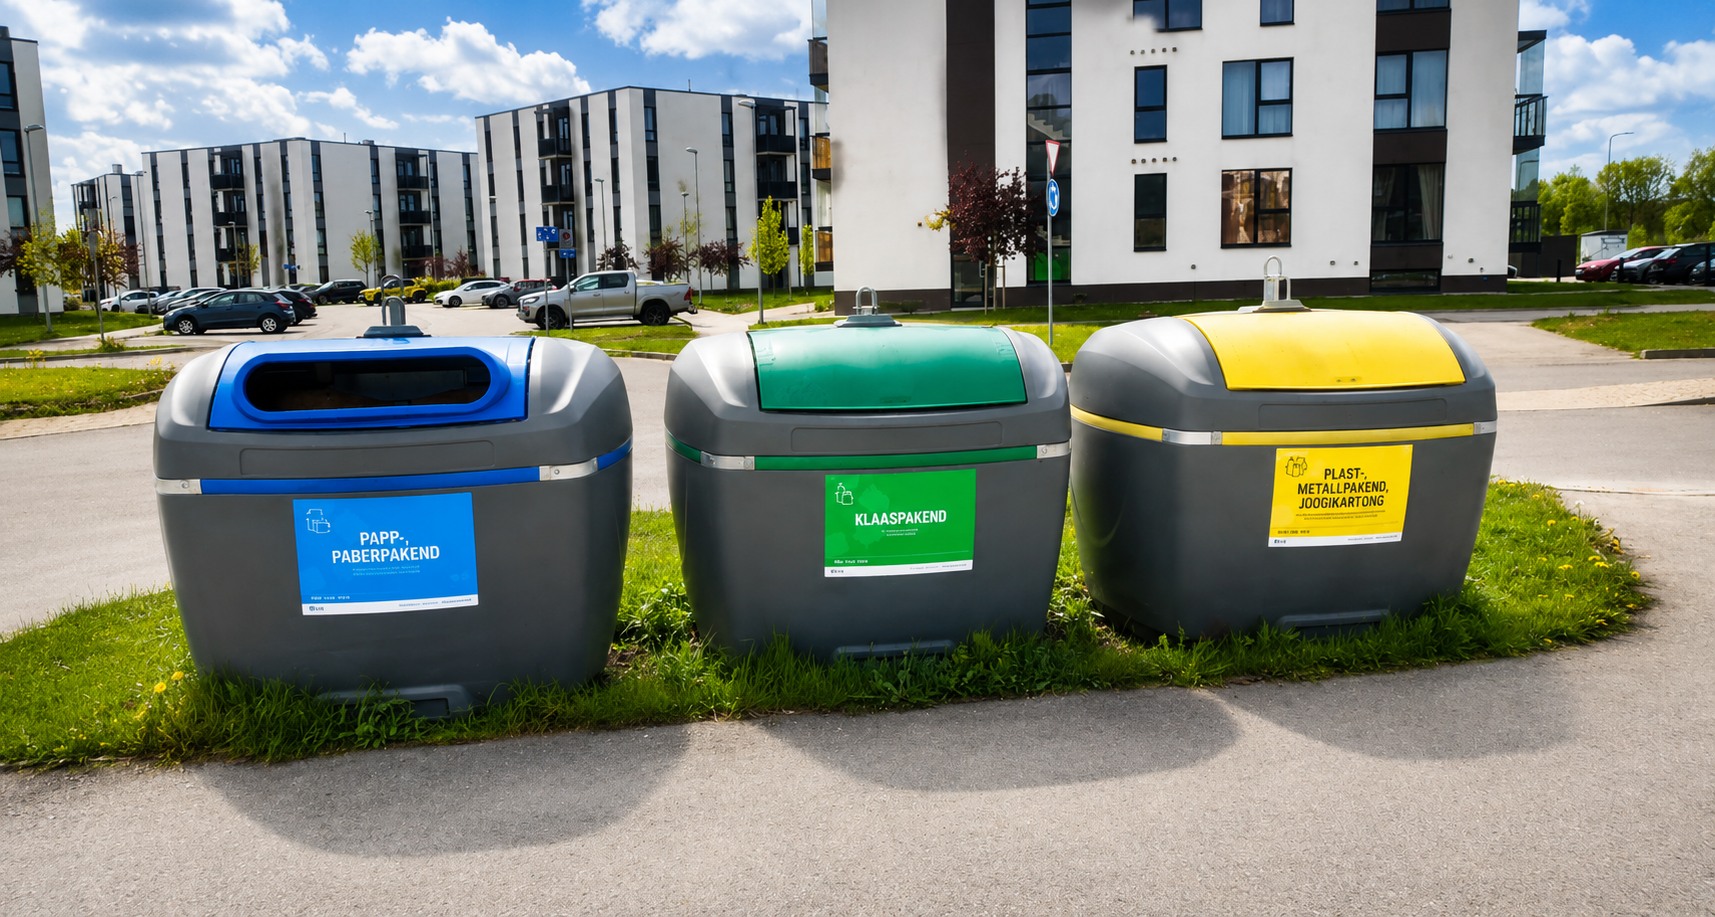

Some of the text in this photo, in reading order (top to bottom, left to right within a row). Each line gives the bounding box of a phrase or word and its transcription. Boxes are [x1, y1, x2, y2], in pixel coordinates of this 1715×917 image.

[1324, 468, 1367, 480] PLAST-,
[1297, 481, 1389, 495] METALLPAKEND,
[1298, 495, 1384, 509] JOOGIKARTONG
[855, 509, 947, 526] KLAASPAKEND
[359, 530, 409, 546] PAPP-,
[331, 545, 440, 564] PABERPAKEND
